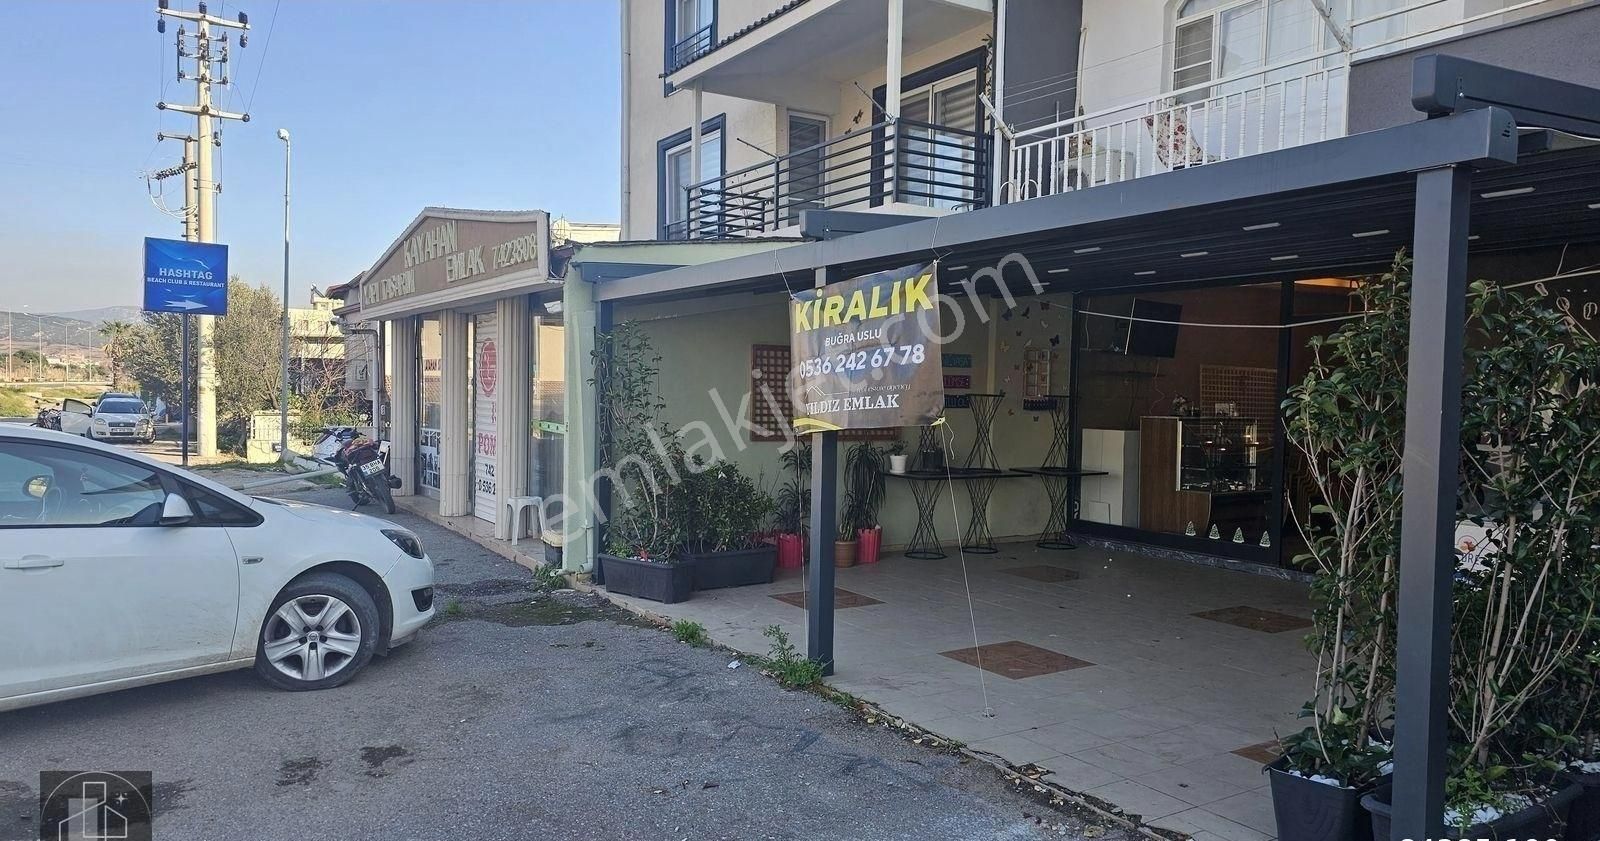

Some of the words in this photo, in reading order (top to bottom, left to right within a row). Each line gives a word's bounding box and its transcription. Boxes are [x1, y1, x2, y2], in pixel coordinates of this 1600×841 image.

[404, 220, 458, 268] KAYAHAN
[159, 267, 213, 280] HASHTAG
[446, 244, 486, 282] EMLAK
[795, 273, 934, 334] KİRALIK
[825, 332, 856, 347] BUĞRA
[857, 328, 882, 342] USLU
[800, 357, 832, 379] 0536
[835, 351, 867, 373] 242
[871, 347, 895, 368] 67
[899, 343, 925, 365] 78
[843, 394, 899, 411] EMLAK
